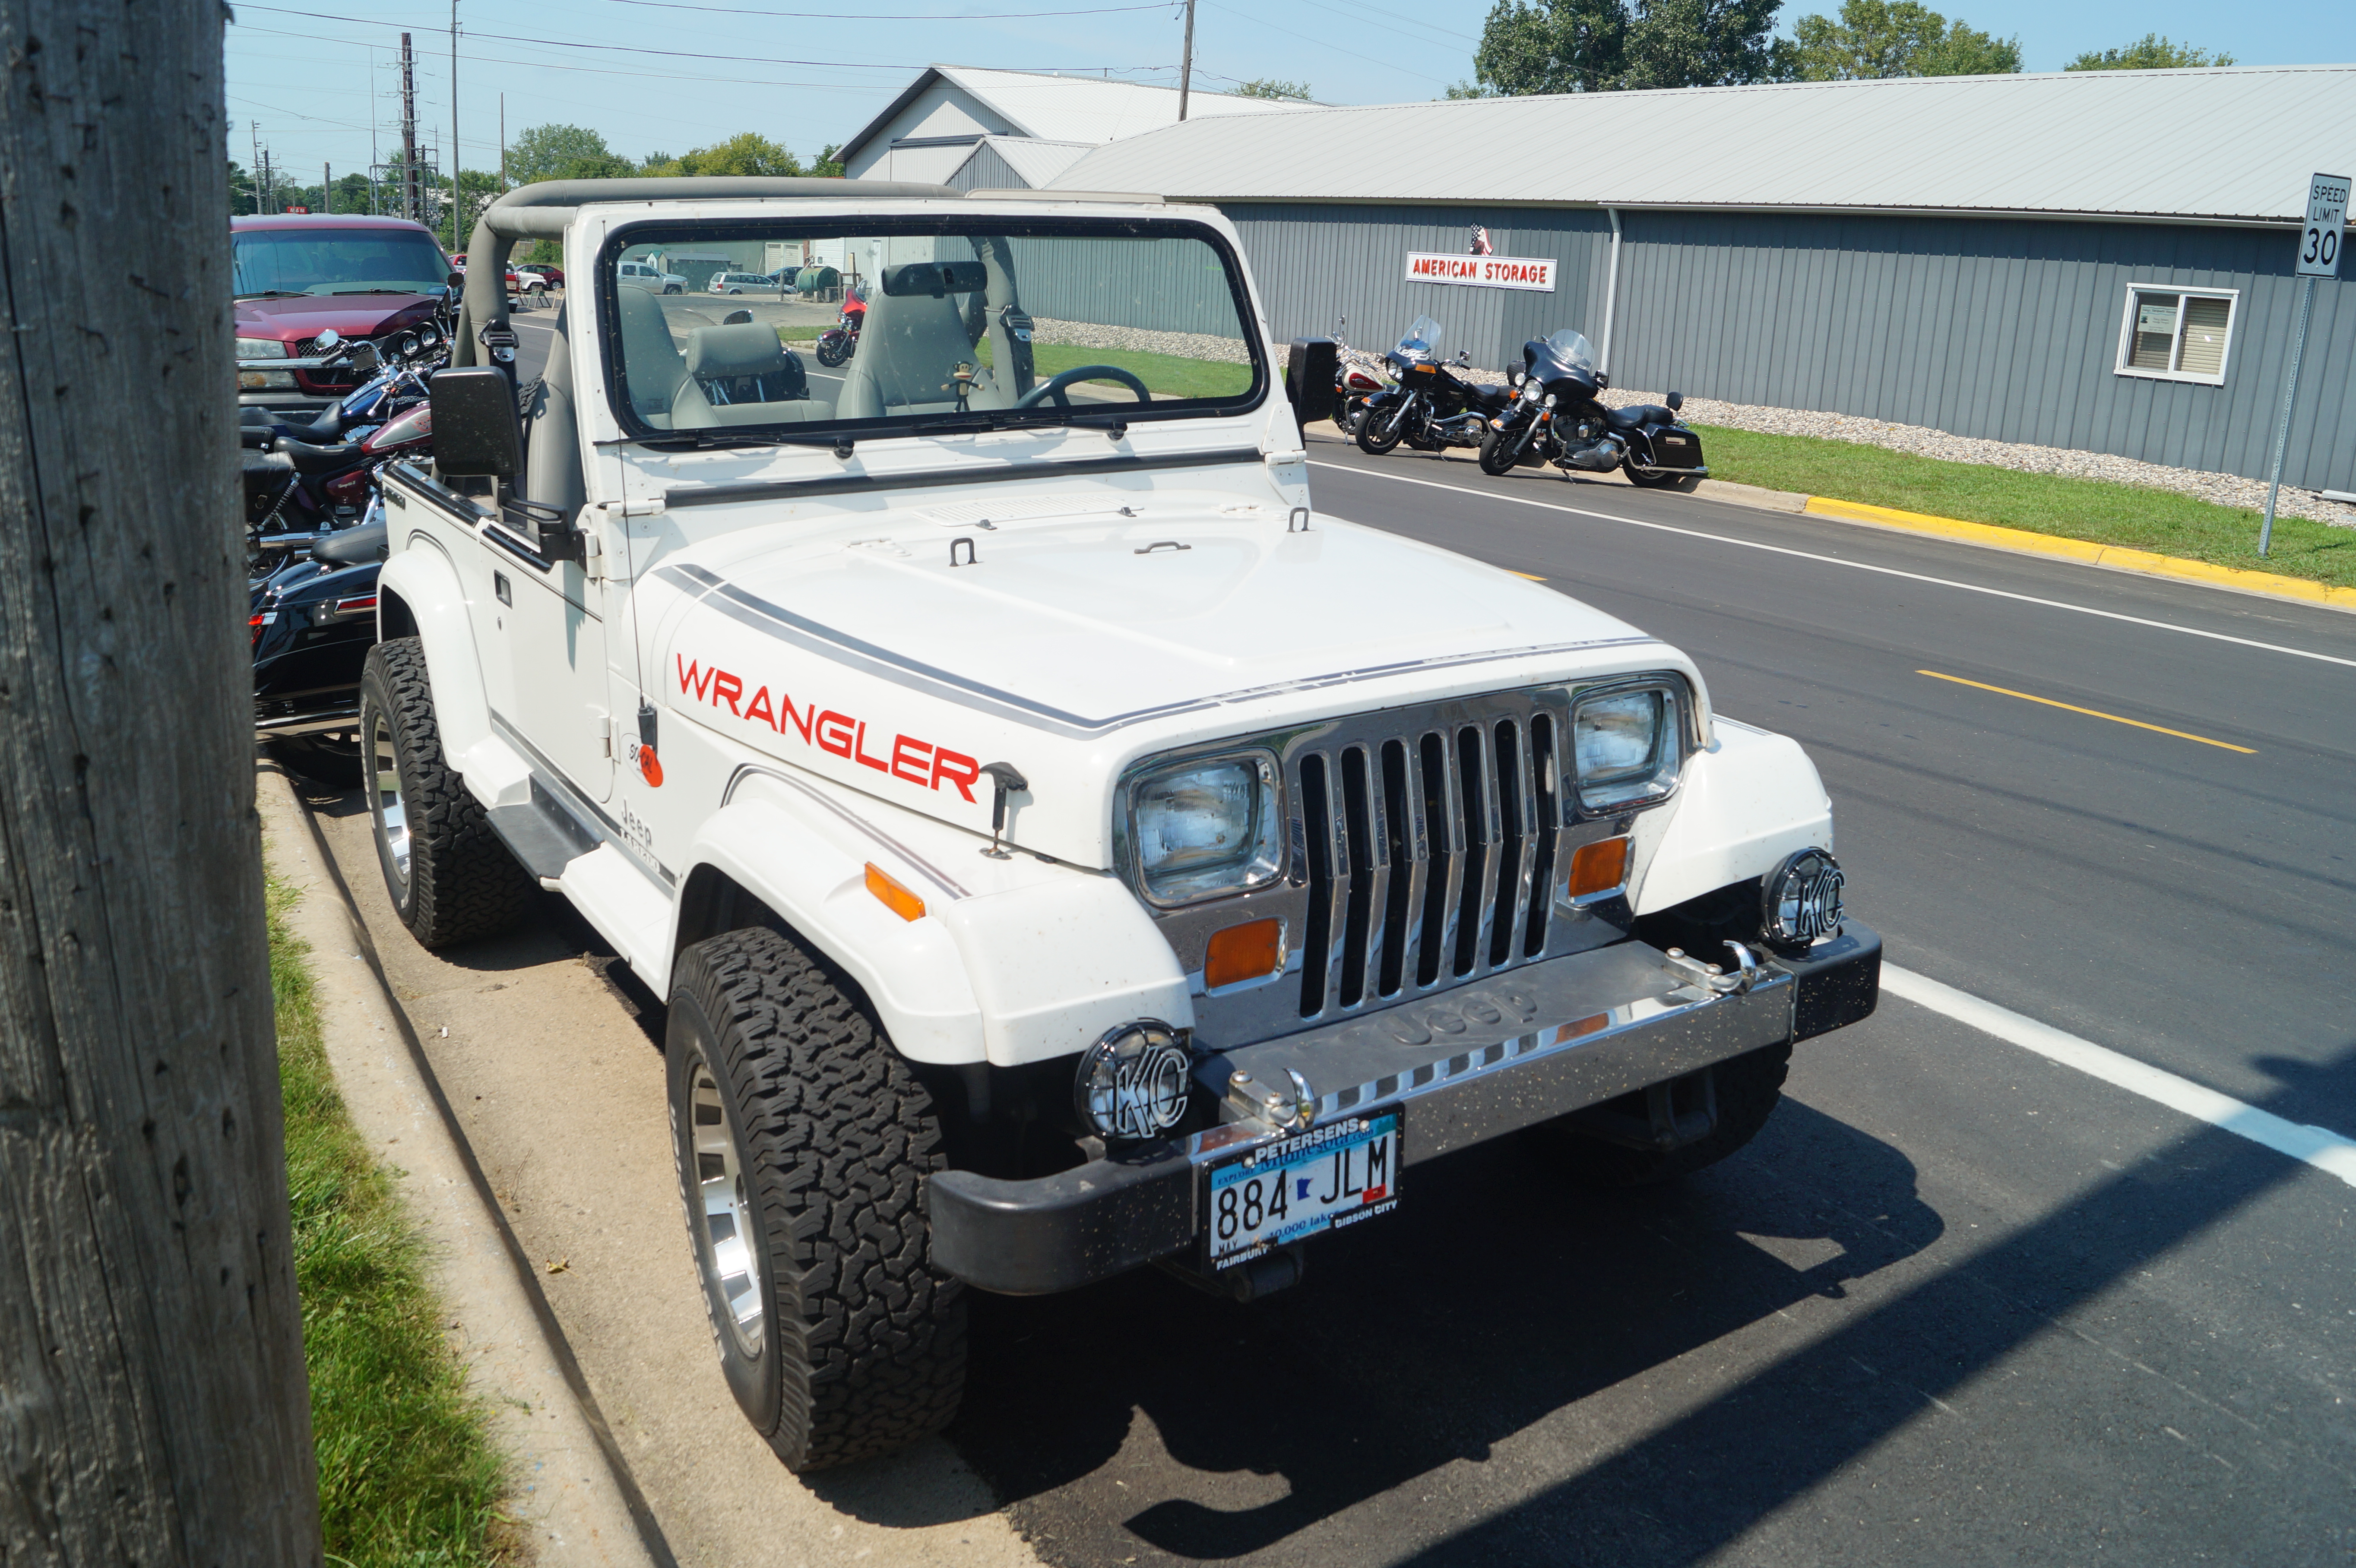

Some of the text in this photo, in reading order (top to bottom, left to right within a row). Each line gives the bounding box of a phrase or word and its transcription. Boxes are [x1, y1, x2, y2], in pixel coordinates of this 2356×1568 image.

[2313, 185, 2346, 203] SPEED
[2313, 206, 2340, 224] LIMIT
[2303, 228, 2337, 266] 30
[1413, 258, 1547, 283] AMERICAN STORAGE
[677, 652, 980, 805] WRANGLER
[621, 799, 652, 848] Jeep
[620, 827, 660, 873] LAREDO
[1800, 865, 1846, 939] KC
[1390, 986, 1537, 1046] Jeep
[1116, 1045, 1189, 1139] KC
[1255, 1118, 1359, 1164] PETERSENS
[1218, 1135, 1388, 1241] 884 JLM
[1335, 1200, 1398, 1229] GIBSON CITY
[1216, 1246, 1269, 1271] FAIRBURY
[1219, 1239, 1238, 1255] MAY
